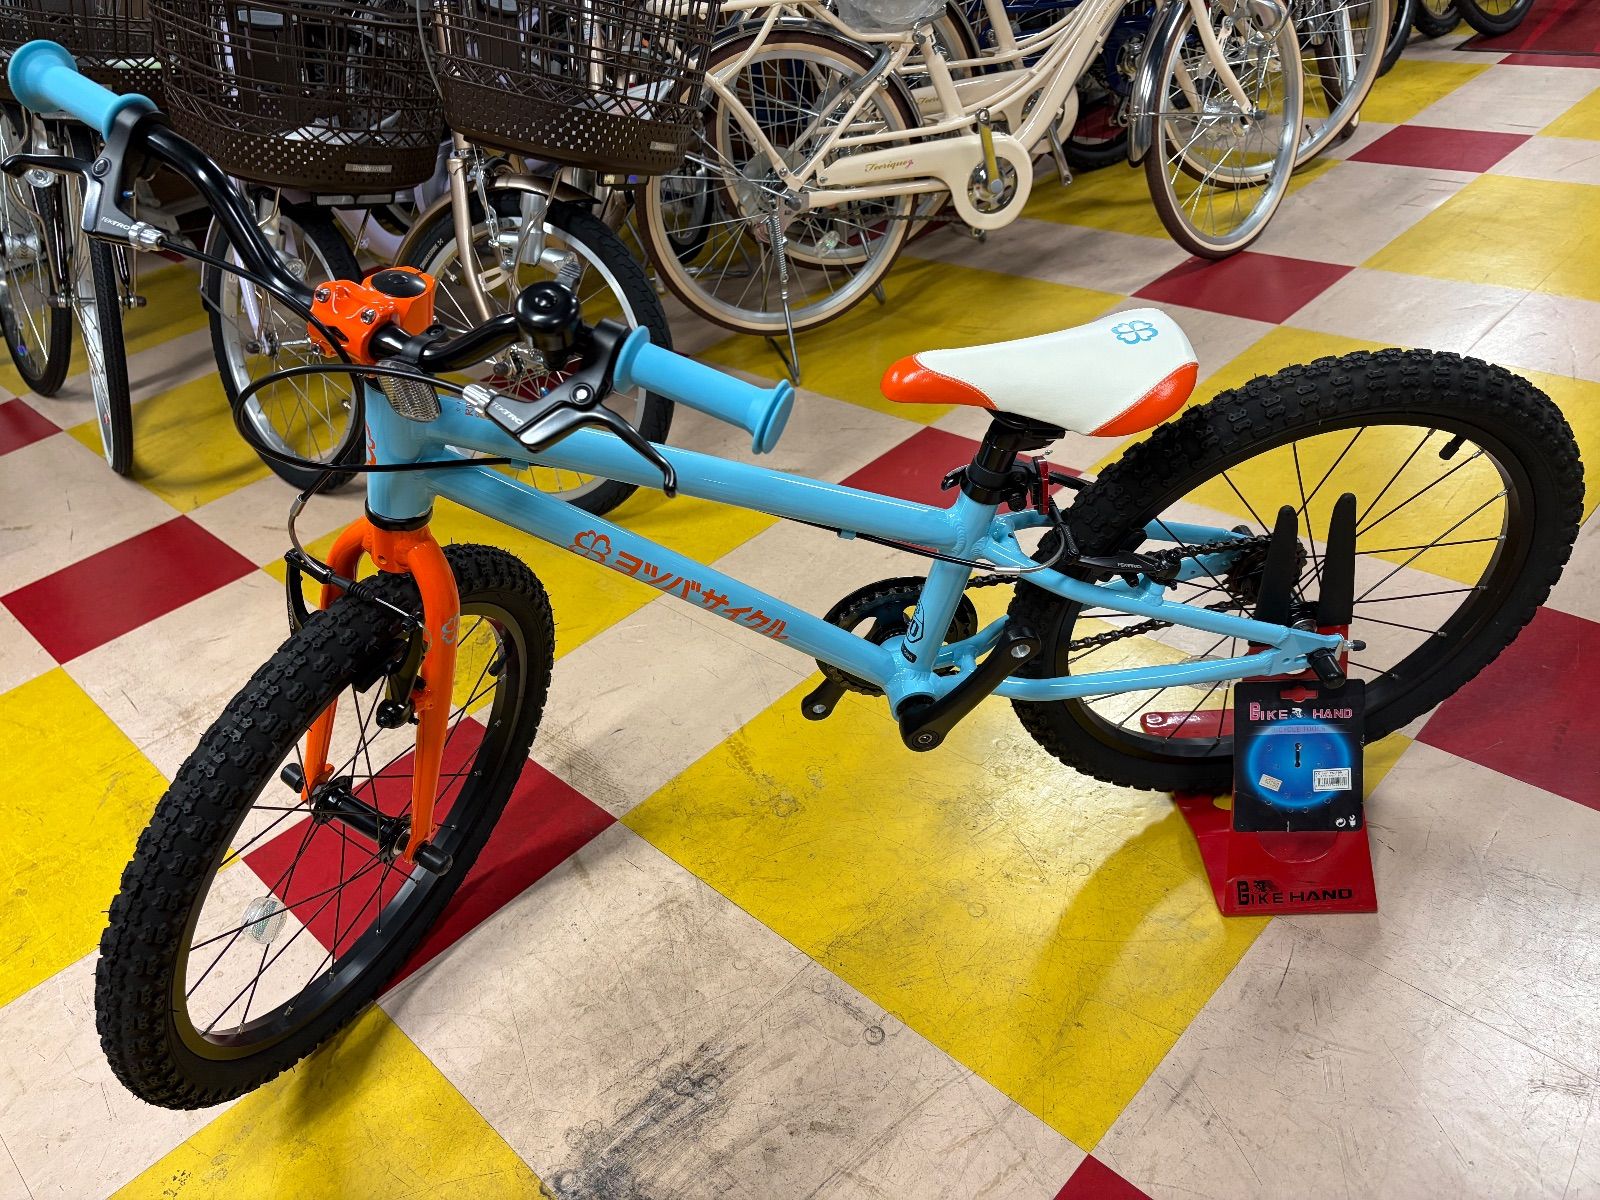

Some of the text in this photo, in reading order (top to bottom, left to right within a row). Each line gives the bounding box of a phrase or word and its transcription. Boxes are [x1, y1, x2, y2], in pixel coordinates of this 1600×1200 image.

[101, 216, 130, 230] TEKTRO
[491, 401, 525, 425] TEKTRO
[608, 550, 789, 640] ヨツバサイクル
[1249, 701, 1353, 721] BIKE HAND
[1236, 880, 1353, 906] BIKE HAND
